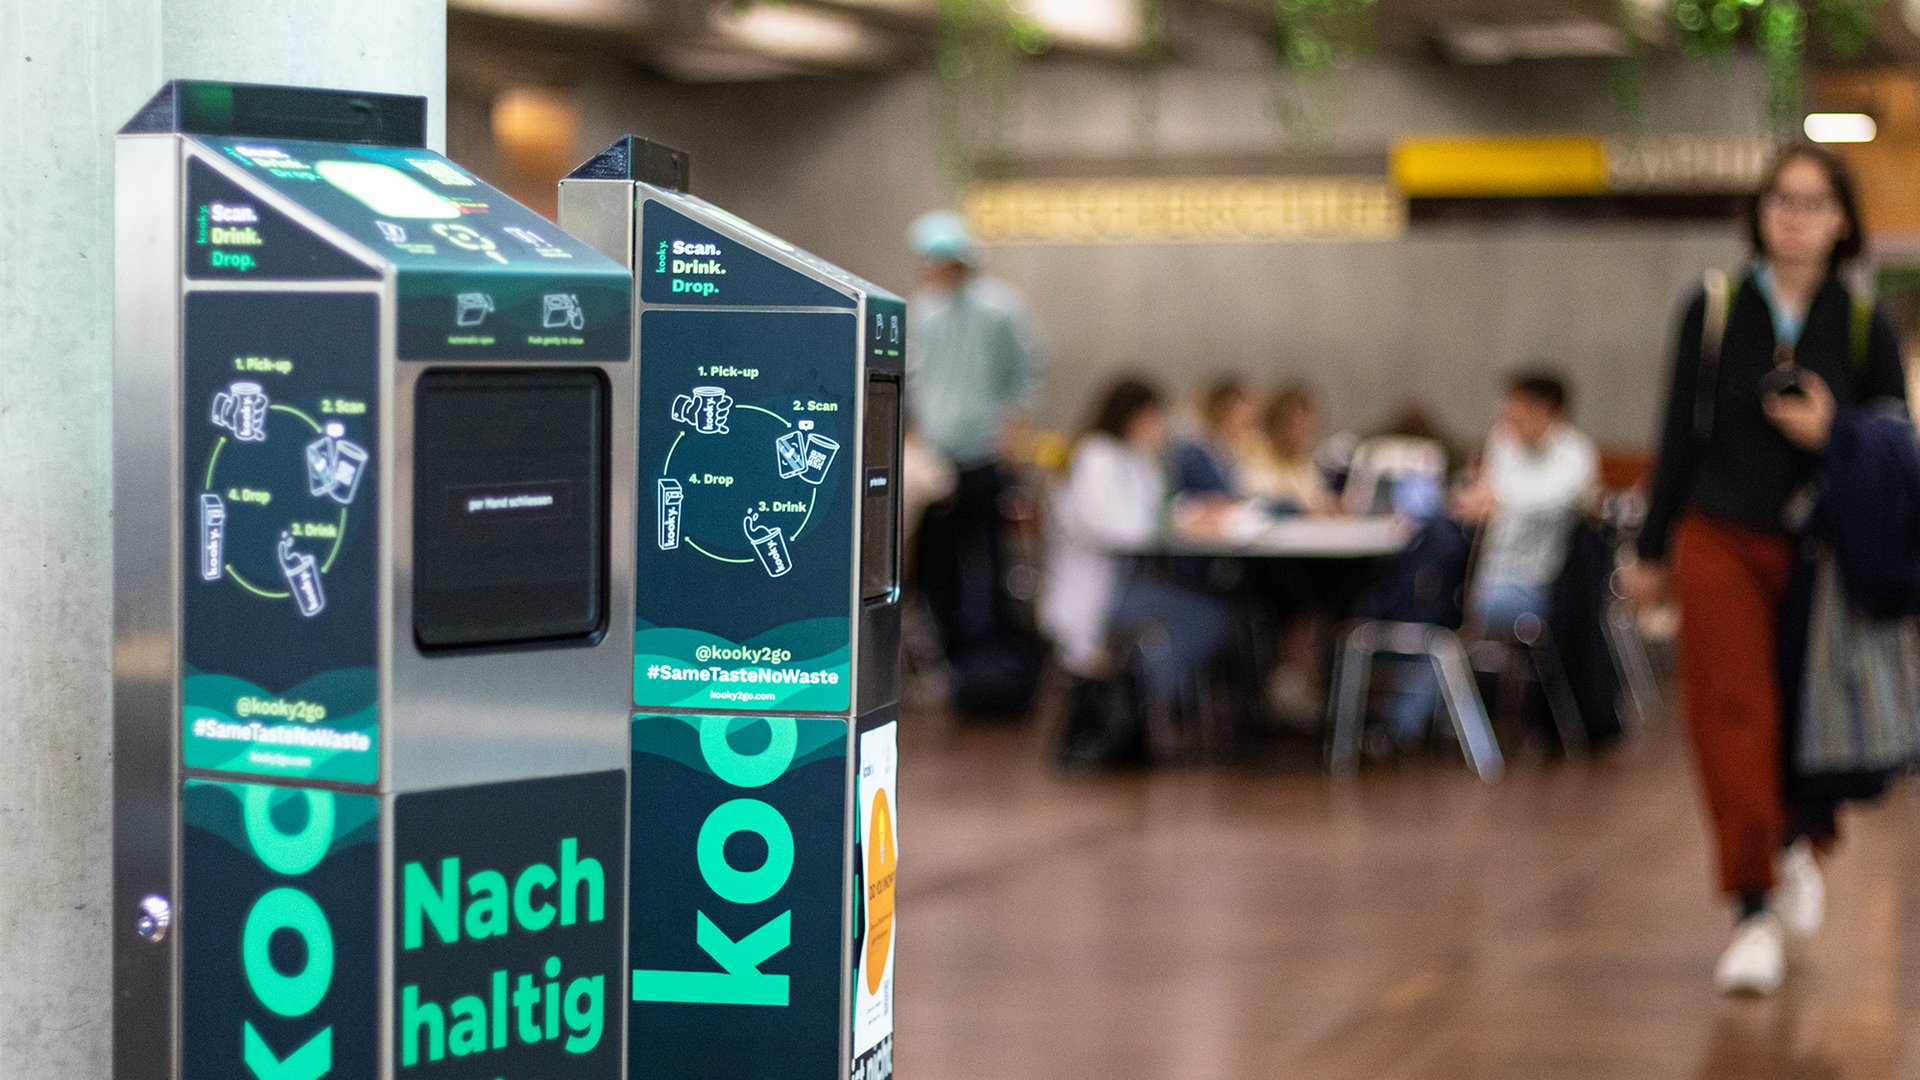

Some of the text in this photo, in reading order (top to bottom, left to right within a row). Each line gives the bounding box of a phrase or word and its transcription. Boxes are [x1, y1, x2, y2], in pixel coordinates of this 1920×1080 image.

[211, 204, 258, 222] Scan.
[211, 227, 262, 245] Drink.
[656, 240, 667, 273] kooky.
[672, 240, 721, 256] Scan.
[211, 250, 257, 271] Drop.
[672, 259, 727, 275] Drink.
[672, 278, 719, 296] Drop.
[235, 358, 293, 374] 1. Pick-up
[698, 366, 759, 379] 1. Pick-up
[322, 399, 366, 414] 2. Scan
[703, 397, 715, 430] kooky.
[793, 401, 838, 412] 2. Scan
[689, 474, 734, 487] 4. Drop
[228, 489, 271, 505] 4. Drop
[758, 502, 807, 513] 3. Drink
[291, 524, 337, 538] 3. Drink
[664, 507, 679, 547] kooky.
[695, 645, 791, 664] @kooky2go
[647, 665, 839, 684] #SameTasteNoWaste
[709, 690, 775, 702] kooky2go.com
[236, 697, 326, 723] @kooky2go
[193, 718, 371, 752] #SameTasteNoWaste
[402, 837, 605, 951] Nach
[402, 955, 605, 1067] haltig
